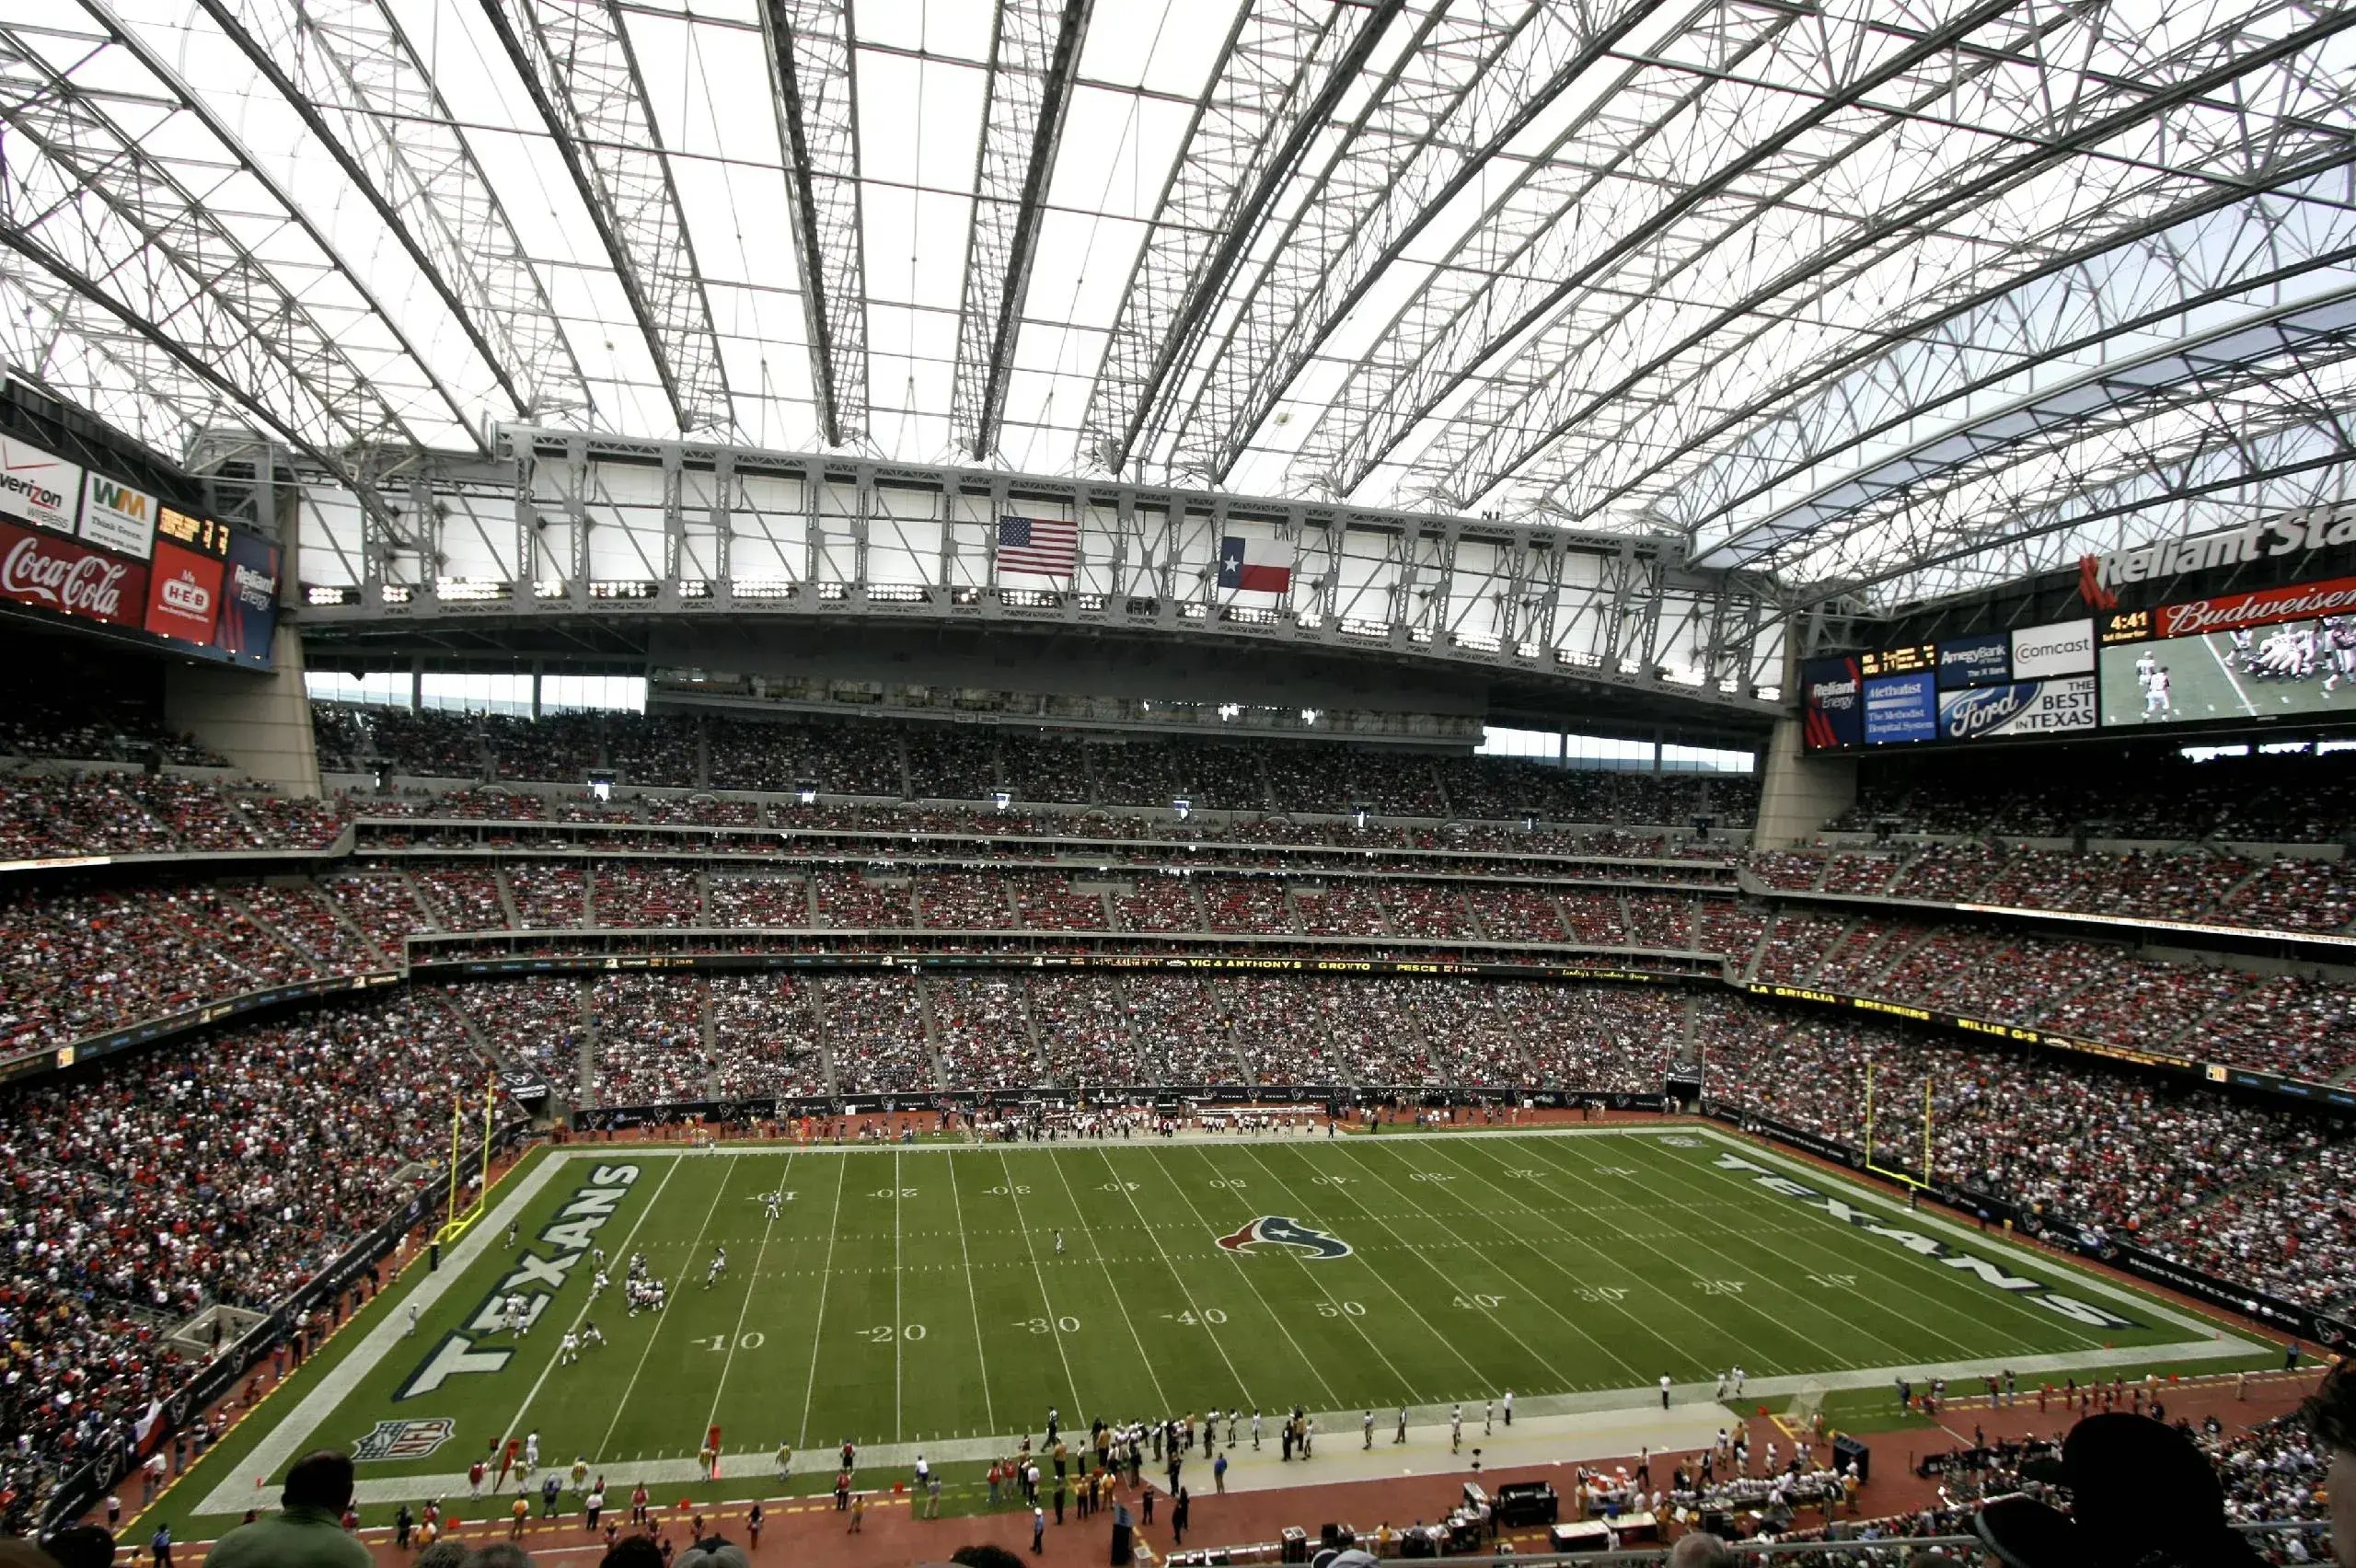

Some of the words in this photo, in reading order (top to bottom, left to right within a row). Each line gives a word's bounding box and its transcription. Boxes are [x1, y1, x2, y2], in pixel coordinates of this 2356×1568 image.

[0, 473, 62, 510] verizon
[94, 477, 146, 521] WM
[2096, 518, 2264, 590] Reliant
[2, 536, 127, 615] Coca-Cola
[235, 563, 276, 594] Reliant
[2110, 611, 2148, 630] 4:41
[2167, 587, 2356, 635] Budweiser
[1813, 679, 1856, 698] Reliant
[1869, 683, 1922, 698] Methodist
[2068, 679, 2096, 691] THE
[2043, 692, 2096, 710] BEST
[1950, 686, 2019, 736] Ford
[2015, 721, 2027, 730] IN
[2027, 709, 2095, 730] TEXAS
[1318, 962, 1370, 970] GROTTO
[1396, 963, 1438, 973] PESCE
[1750, 984, 1768, 994] LA
[1775, 986, 1835, 1003] GRIGLIA
[1957, 1018, 2006, 1037] WILLIE
[394, 1162, 641, 1401] TEXANS
[1452, 1293, 1498, 1309] 40
[1573, 1286, 1623, 1302] 30
[1175, 1308, 1229, 1326] 40
[1314, 1301, 1366, 1319] 50
[870, 1324, 927, 1343] 20
[1028, 1316, 1080, 1334] 30
[705, 1332, 765, 1352] 10
